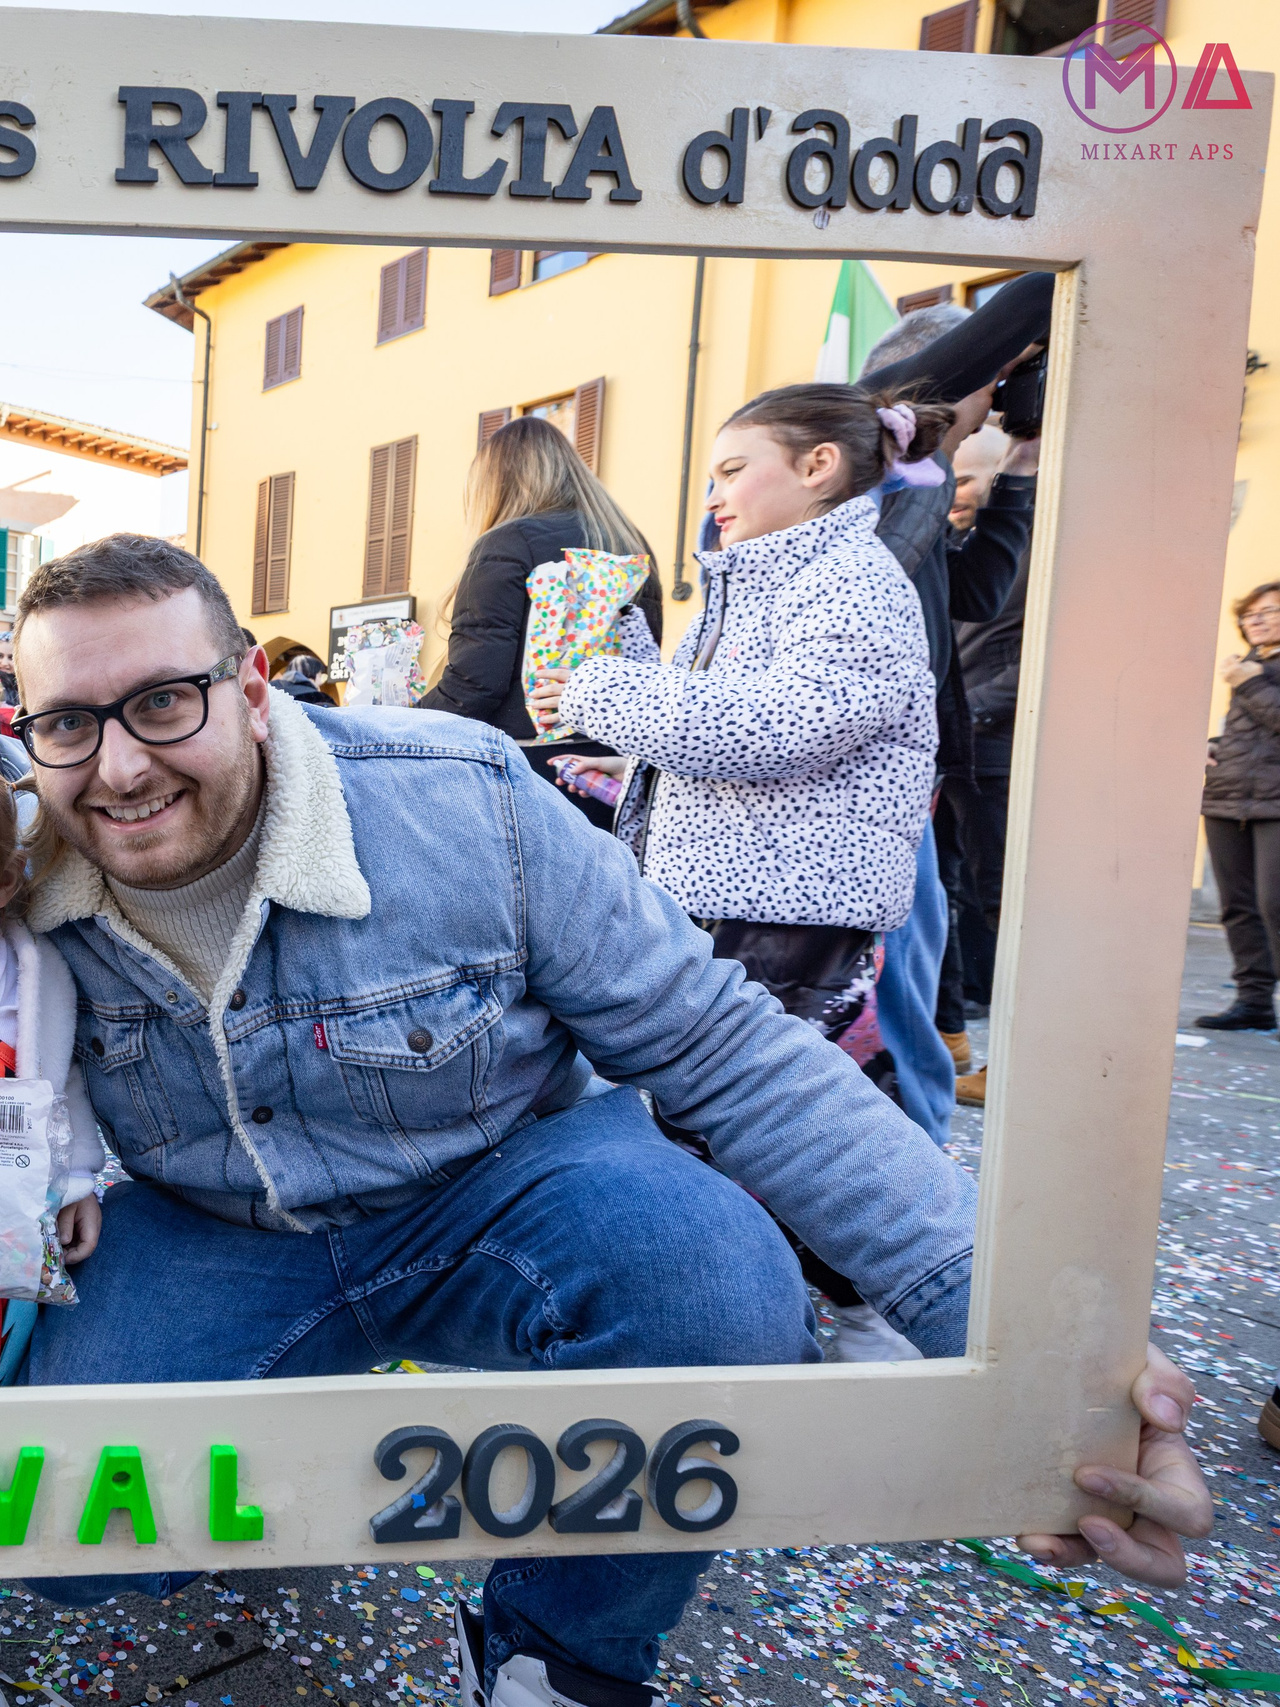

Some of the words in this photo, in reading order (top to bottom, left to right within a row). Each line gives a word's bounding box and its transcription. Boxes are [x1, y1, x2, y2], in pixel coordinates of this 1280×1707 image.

[114, 85, 643, 204] RIVOLTA
[681, 105, 1043, 218] d'adda
[368, 1416, 741, 1545] 2026
